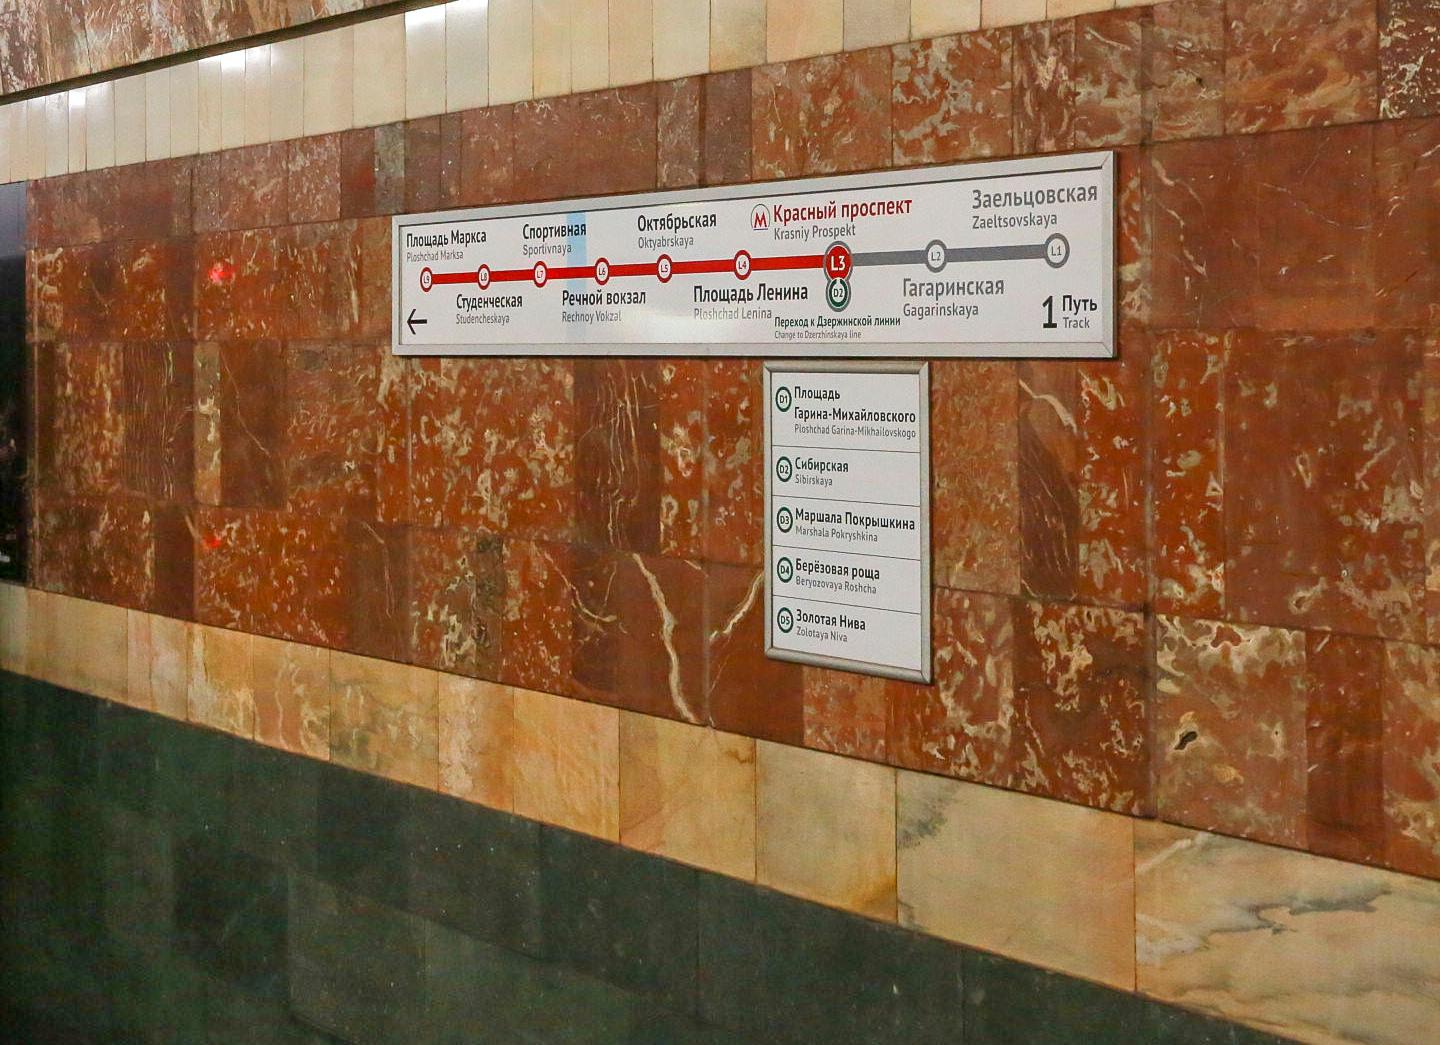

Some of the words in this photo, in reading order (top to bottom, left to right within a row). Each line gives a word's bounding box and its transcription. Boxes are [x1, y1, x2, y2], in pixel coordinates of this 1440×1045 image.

[972, 185, 1098, 210] Заельцовская
[773, 203, 836, 224] Красный
[841, 199, 913, 222] проспект
[637, 212, 717, 232] Октябрьская
[972, 213, 1058, 229] Zaeltsovskaya
[406, 231, 448, 249] Площадь
[451, 229, 487, 246] Маркса
[523, 223, 587, 241] Спортивная
[774, 226, 810, 241] Krasniy
[812, 225, 856, 239] Prospekt
[523, 243, 572, 257] Sportivnaya
[638, 235, 694, 250] Oktyabrskaya
[406, 250, 439, 262] Ploshchad
[440, 249, 464, 261] Marksa
[931, 251, 941, 262] L2
[1051, 245, 1062, 257] L1
[660, 263, 669, 274] L5
[738, 260, 747, 270] L4
[831, 255, 846, 271] L3
[536, 269, 544, 279] L7
[598, 266, 606, 277] L6
[693, 285, 754, 305] Площадь
[757, 284, 808, 300] Ленина
[833, 287, 844, 299] D2
[903, 277, 1005, 299] Гагаринская
[456, 293, 523, 312] Студенческая
[562, 289, 603, 307] Речной
[606, 291, 646, 305] вокзал
[1062, 294, 1098, 314] Путь
[456, 313, 510, 325] Studencheskaya
[562, 310, 593, 324] Rechnoy
[595, 310, 622, 322] Vokzal
[694, 308, 739, 320] Ploshchad
[741, 308, 772, 320] Lenina
[903, 303, 979, 320] Gagarinskaya
[1042, 295, 1058, 329] 1
[775, 317, 809, 329] Переход
[810, 319, 815, 327] к
[817, 315, 872, 329] Дзержинской
[874, 317, 901, 326] линии
[1063, 317, 1090, 329] Track
[775, 331, 796, 341] Change
[797, 331, 804, 339] to
[805, 330, 848, 340] Dzerzhinskaya
[849, 330, 861, 338] line
[779, 394, 788, 404] D1
[794, 386, 841, 401] Площадь
[794, 407, 916, 423] Гарина-Михайловского
[795, 424, 830, 435] Ploshchad
[779, 465, 789, 474] D2
[795, 457, 849, 473] Сибирская
[795, 475, 833, 488] Sibirskaya
[795, 508, 842, 524] Маршала
[845, 512, 915, 530] Покрышкина
[795, 525, 829, 537] Marshala
[831, 529, 878, 542] Pokryshkina
[795, 558, 849, 576] Берёзовая
[851, 568, 880, 582] роща
[795, 576, 843, 592] Beryozovaya
[845, 581, 877, 594] Roshcha
[796, 609, 837, 626] Золотая
[839, 615, 866, 630] Нива
[796, 627, 829, 640] Zolotaya
[830, 630, 848, 642] Niva
